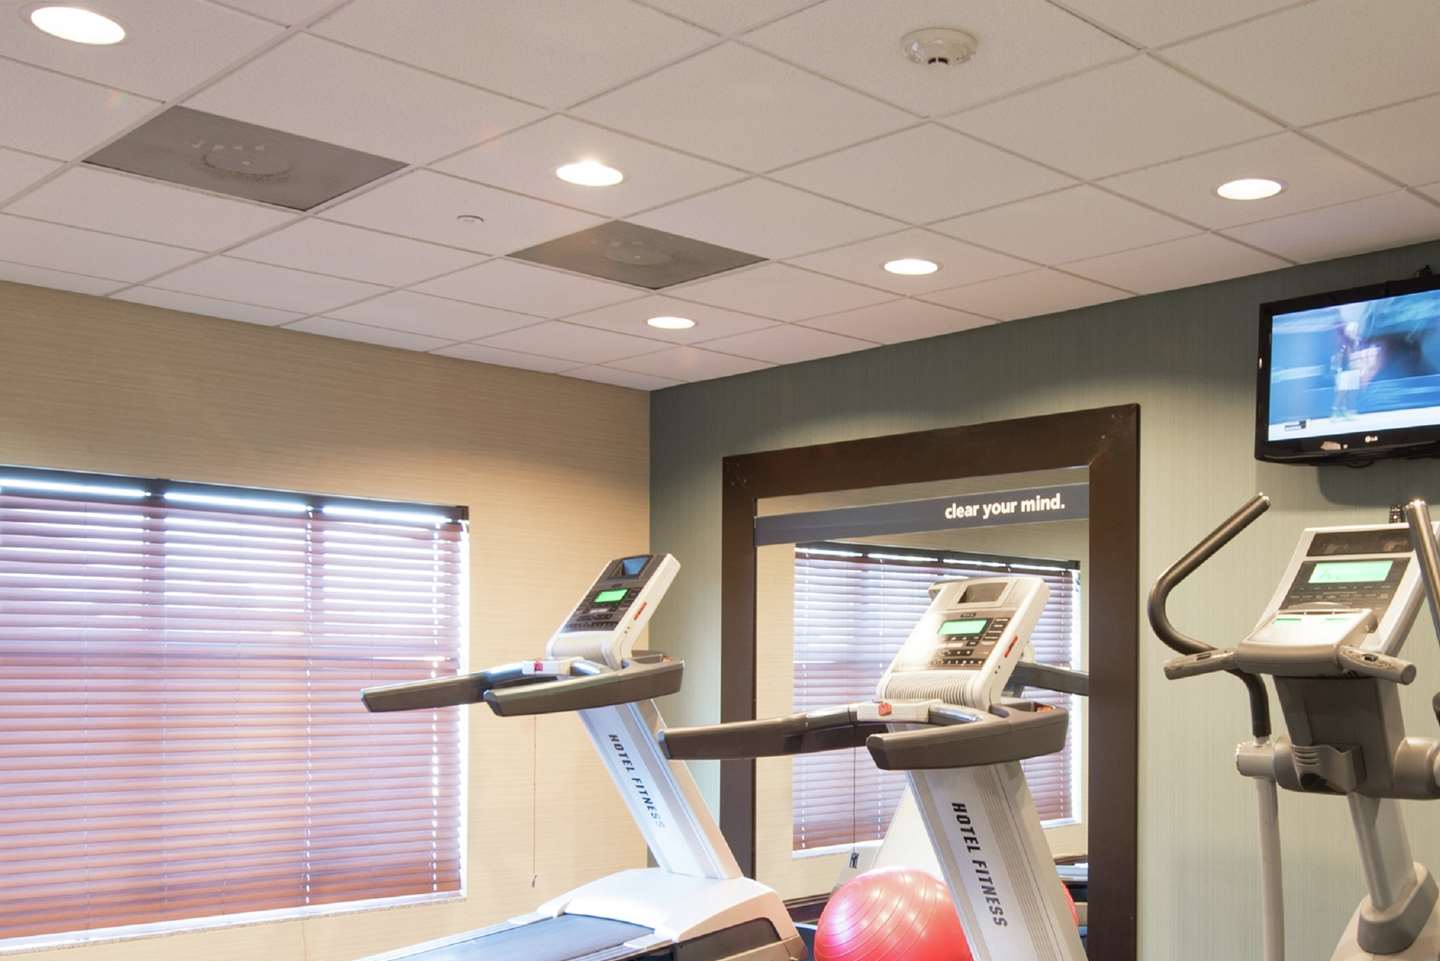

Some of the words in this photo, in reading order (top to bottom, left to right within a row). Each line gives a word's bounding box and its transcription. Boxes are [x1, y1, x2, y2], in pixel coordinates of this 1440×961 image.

[945, 503, 979, 519] clear
[983, 501, 1017, 519] your
[1021, 493, 1065, 512] mind.
[608, 733, 635, 772] HOTEL
[951, 802, 981, 853] HOTEL
[972, 859, 1008, 928] FITNESS
